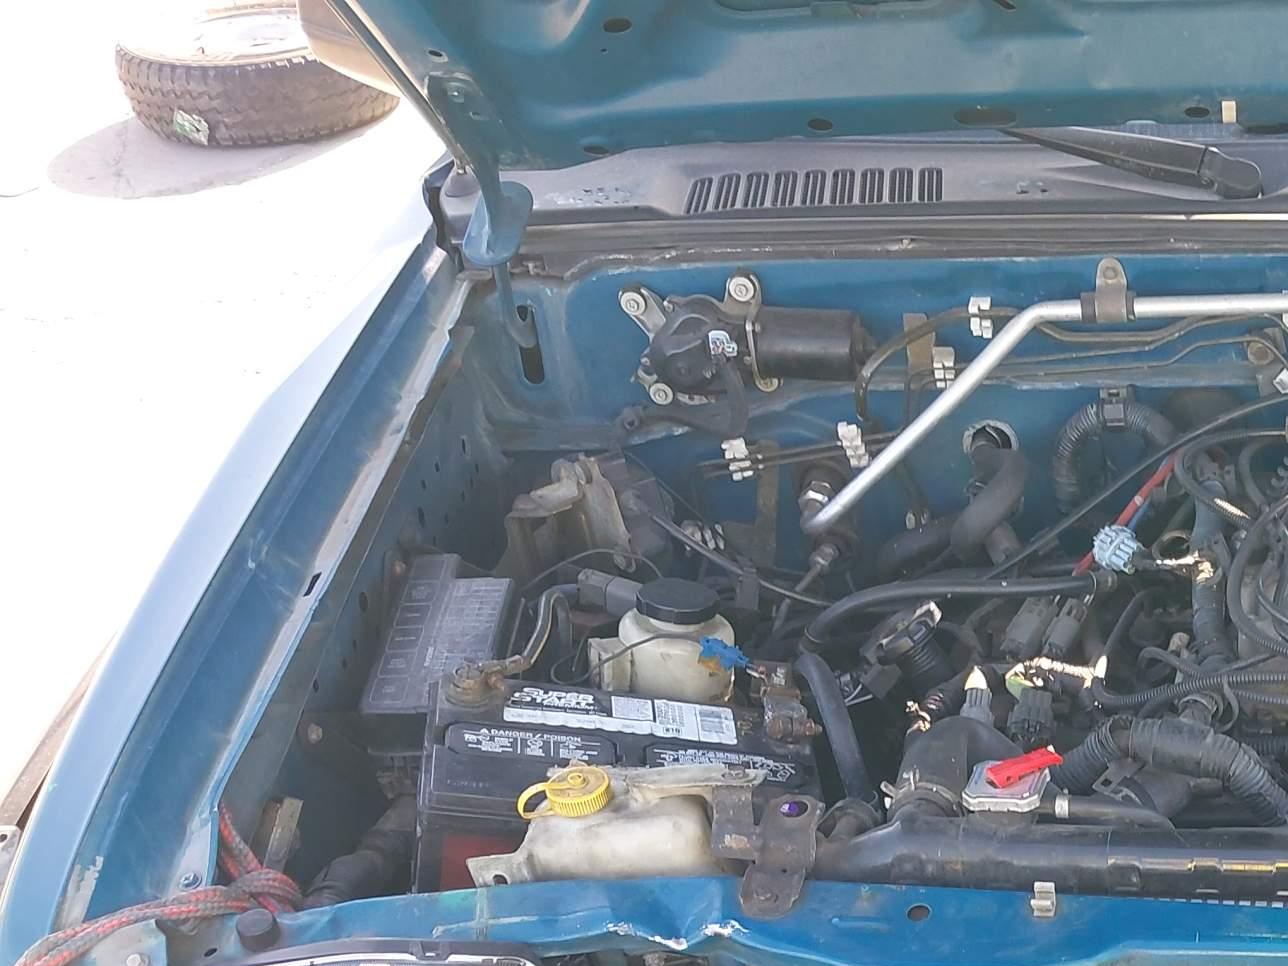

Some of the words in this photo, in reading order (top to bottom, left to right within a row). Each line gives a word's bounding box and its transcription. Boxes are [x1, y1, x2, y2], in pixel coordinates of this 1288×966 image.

[513, 691, 589, 706] START
[522, 686, 595, 703] SUPER
[490, 728, 533, 739] DANGER
[543, 733, 581, 742] POISON
